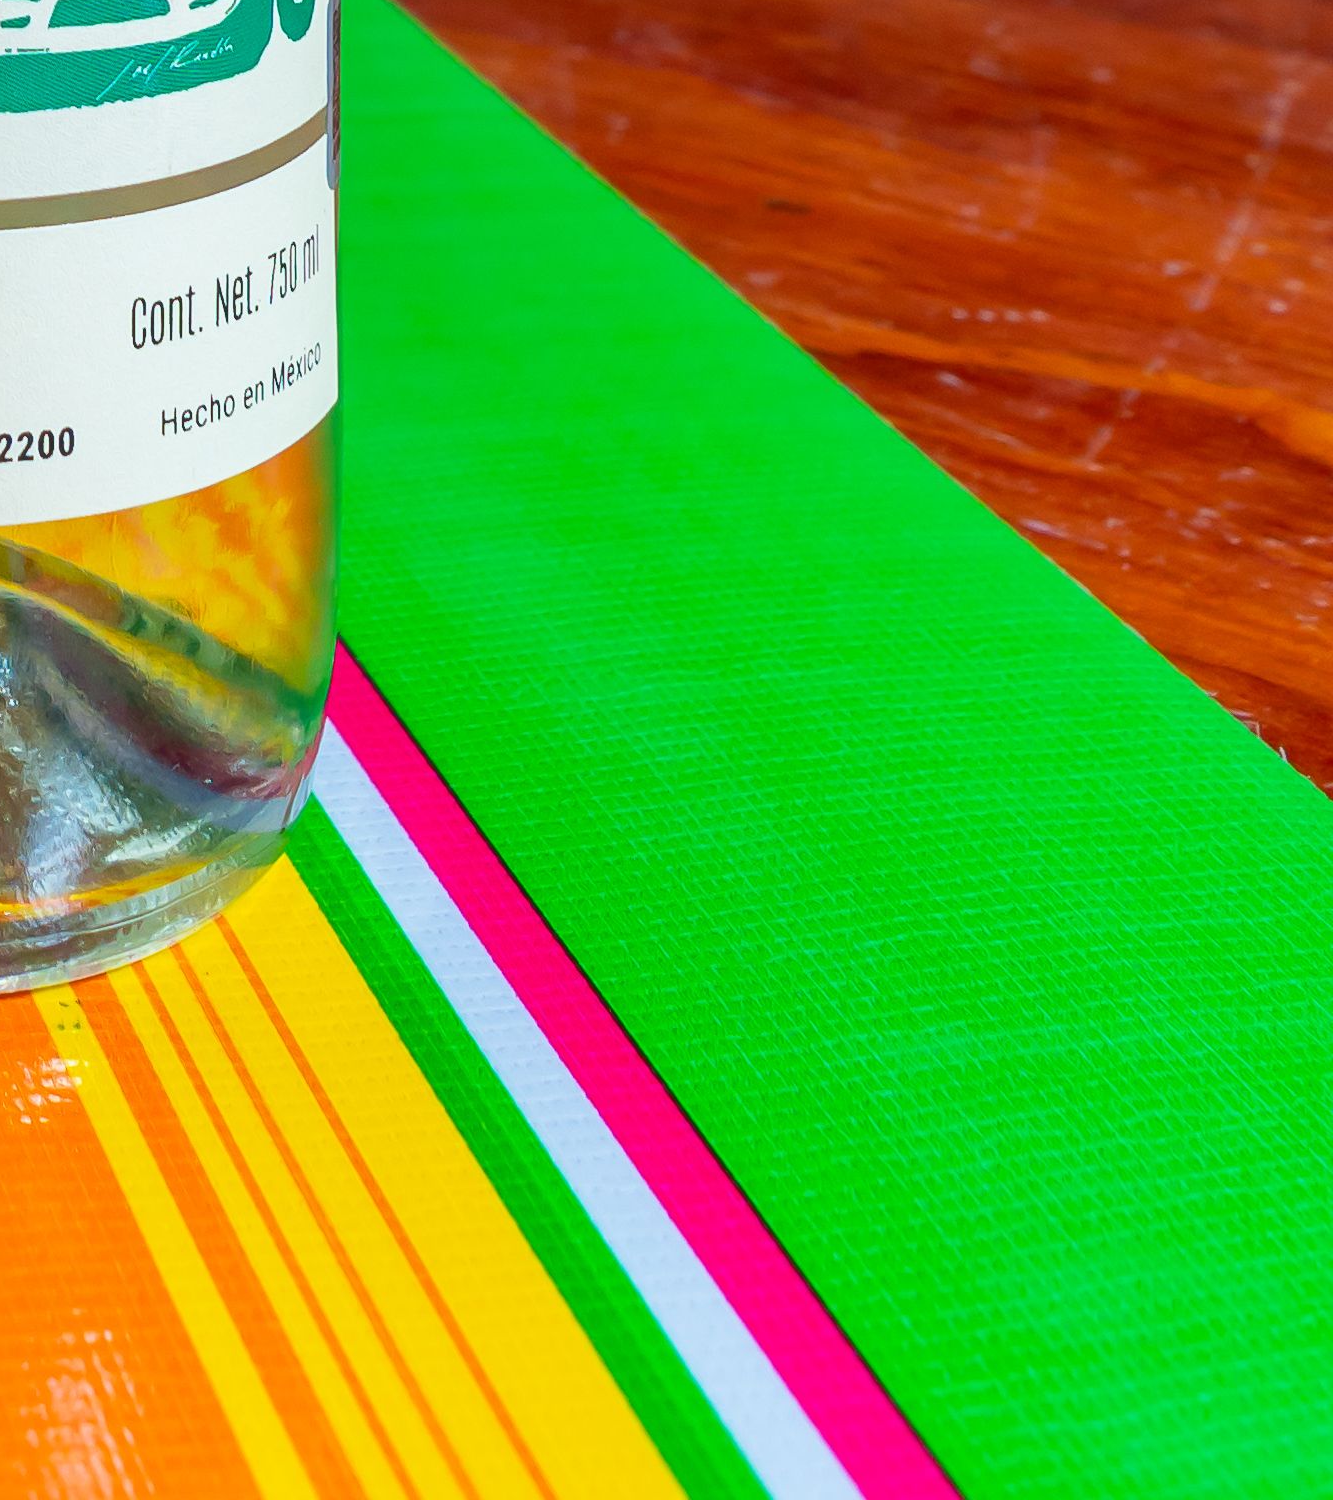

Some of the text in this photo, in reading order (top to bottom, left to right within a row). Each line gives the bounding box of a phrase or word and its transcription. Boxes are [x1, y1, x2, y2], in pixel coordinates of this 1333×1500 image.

[131, 223, 320, 350] Cont. Net. 750 ml
[161, 341, 322, 437] Hecho en México
